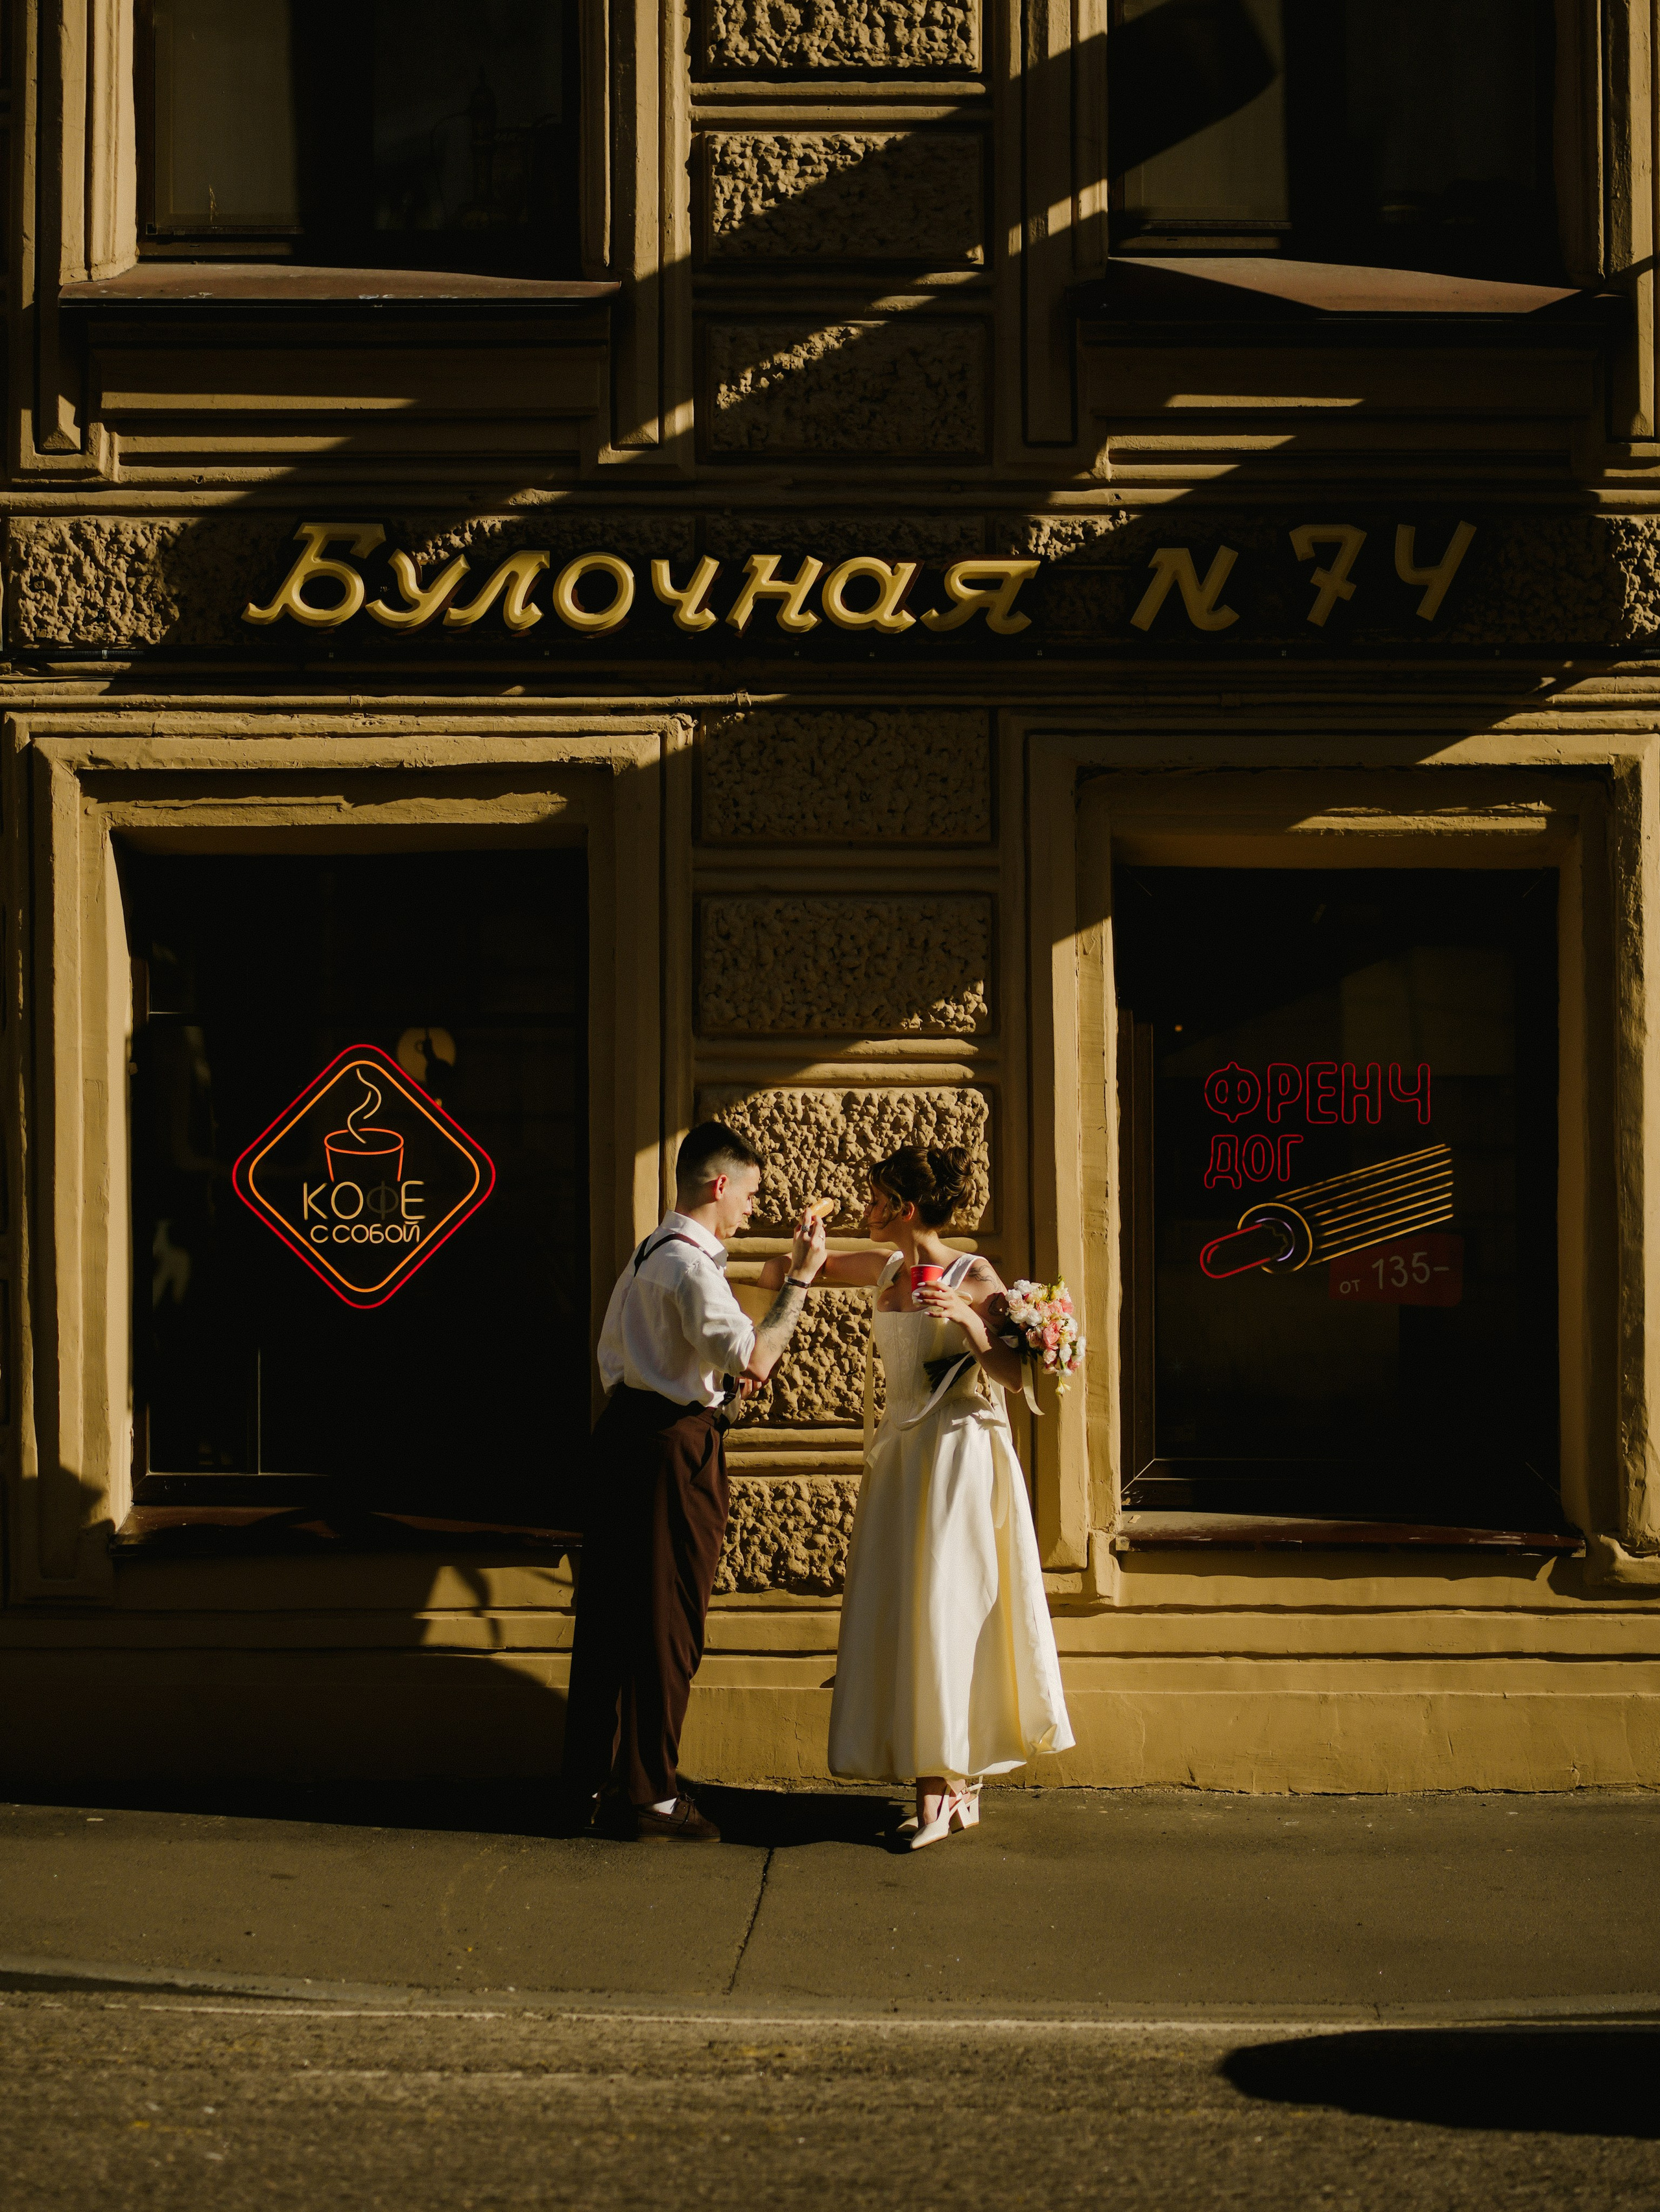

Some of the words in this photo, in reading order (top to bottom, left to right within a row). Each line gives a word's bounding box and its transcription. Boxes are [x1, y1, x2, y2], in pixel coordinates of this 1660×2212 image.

[241, 522, 1041, 635] Булочная
[1204, 1062, 1430, 1124] ФРЕНЧ
[1204, 1134, 1303, 1189] ДОГ
[303, 1180, 426, 1221] КОФЕ
